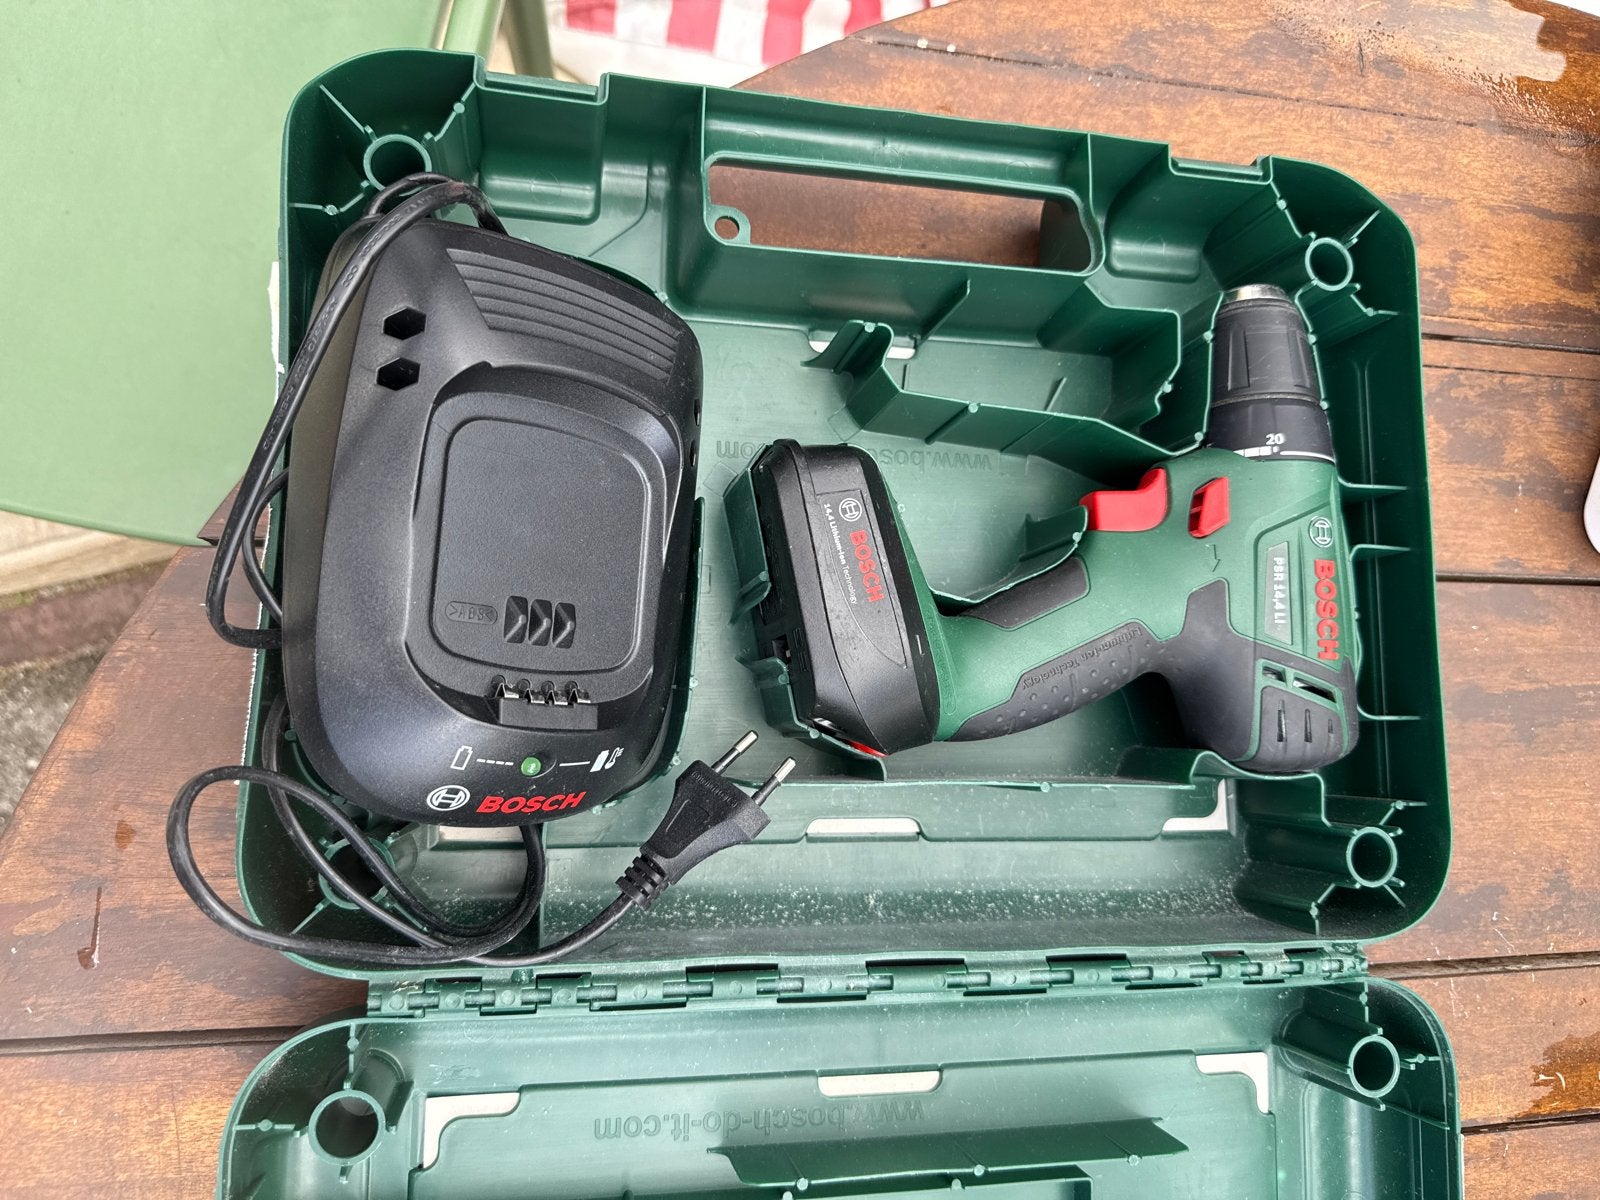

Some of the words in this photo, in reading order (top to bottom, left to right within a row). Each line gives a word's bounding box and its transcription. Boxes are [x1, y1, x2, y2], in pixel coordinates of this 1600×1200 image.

[1266, 432, 1285, 446] 20
[824, 503, 835, 521] 14,4
[829, 521, 847, 564] Lithium-Ion
[850, 529, 885, 603] BOSCH
[1273, 557, 1286, 581] PSR
[842, 565, 858, 605] Technology
[1272, 584, 1287, 610] 14,4
[1274, 612, 1287, 624] LI
[1314, 559, 1340, 661] BOSCH
[1081, 627, 1142, 661] Lithium-Ion
[1022, 660, 1081, 690] Technology
[476, 791, 586, 814] BOSCH
[594, 1099, 925, 1142] www.bosch-do-it.com
